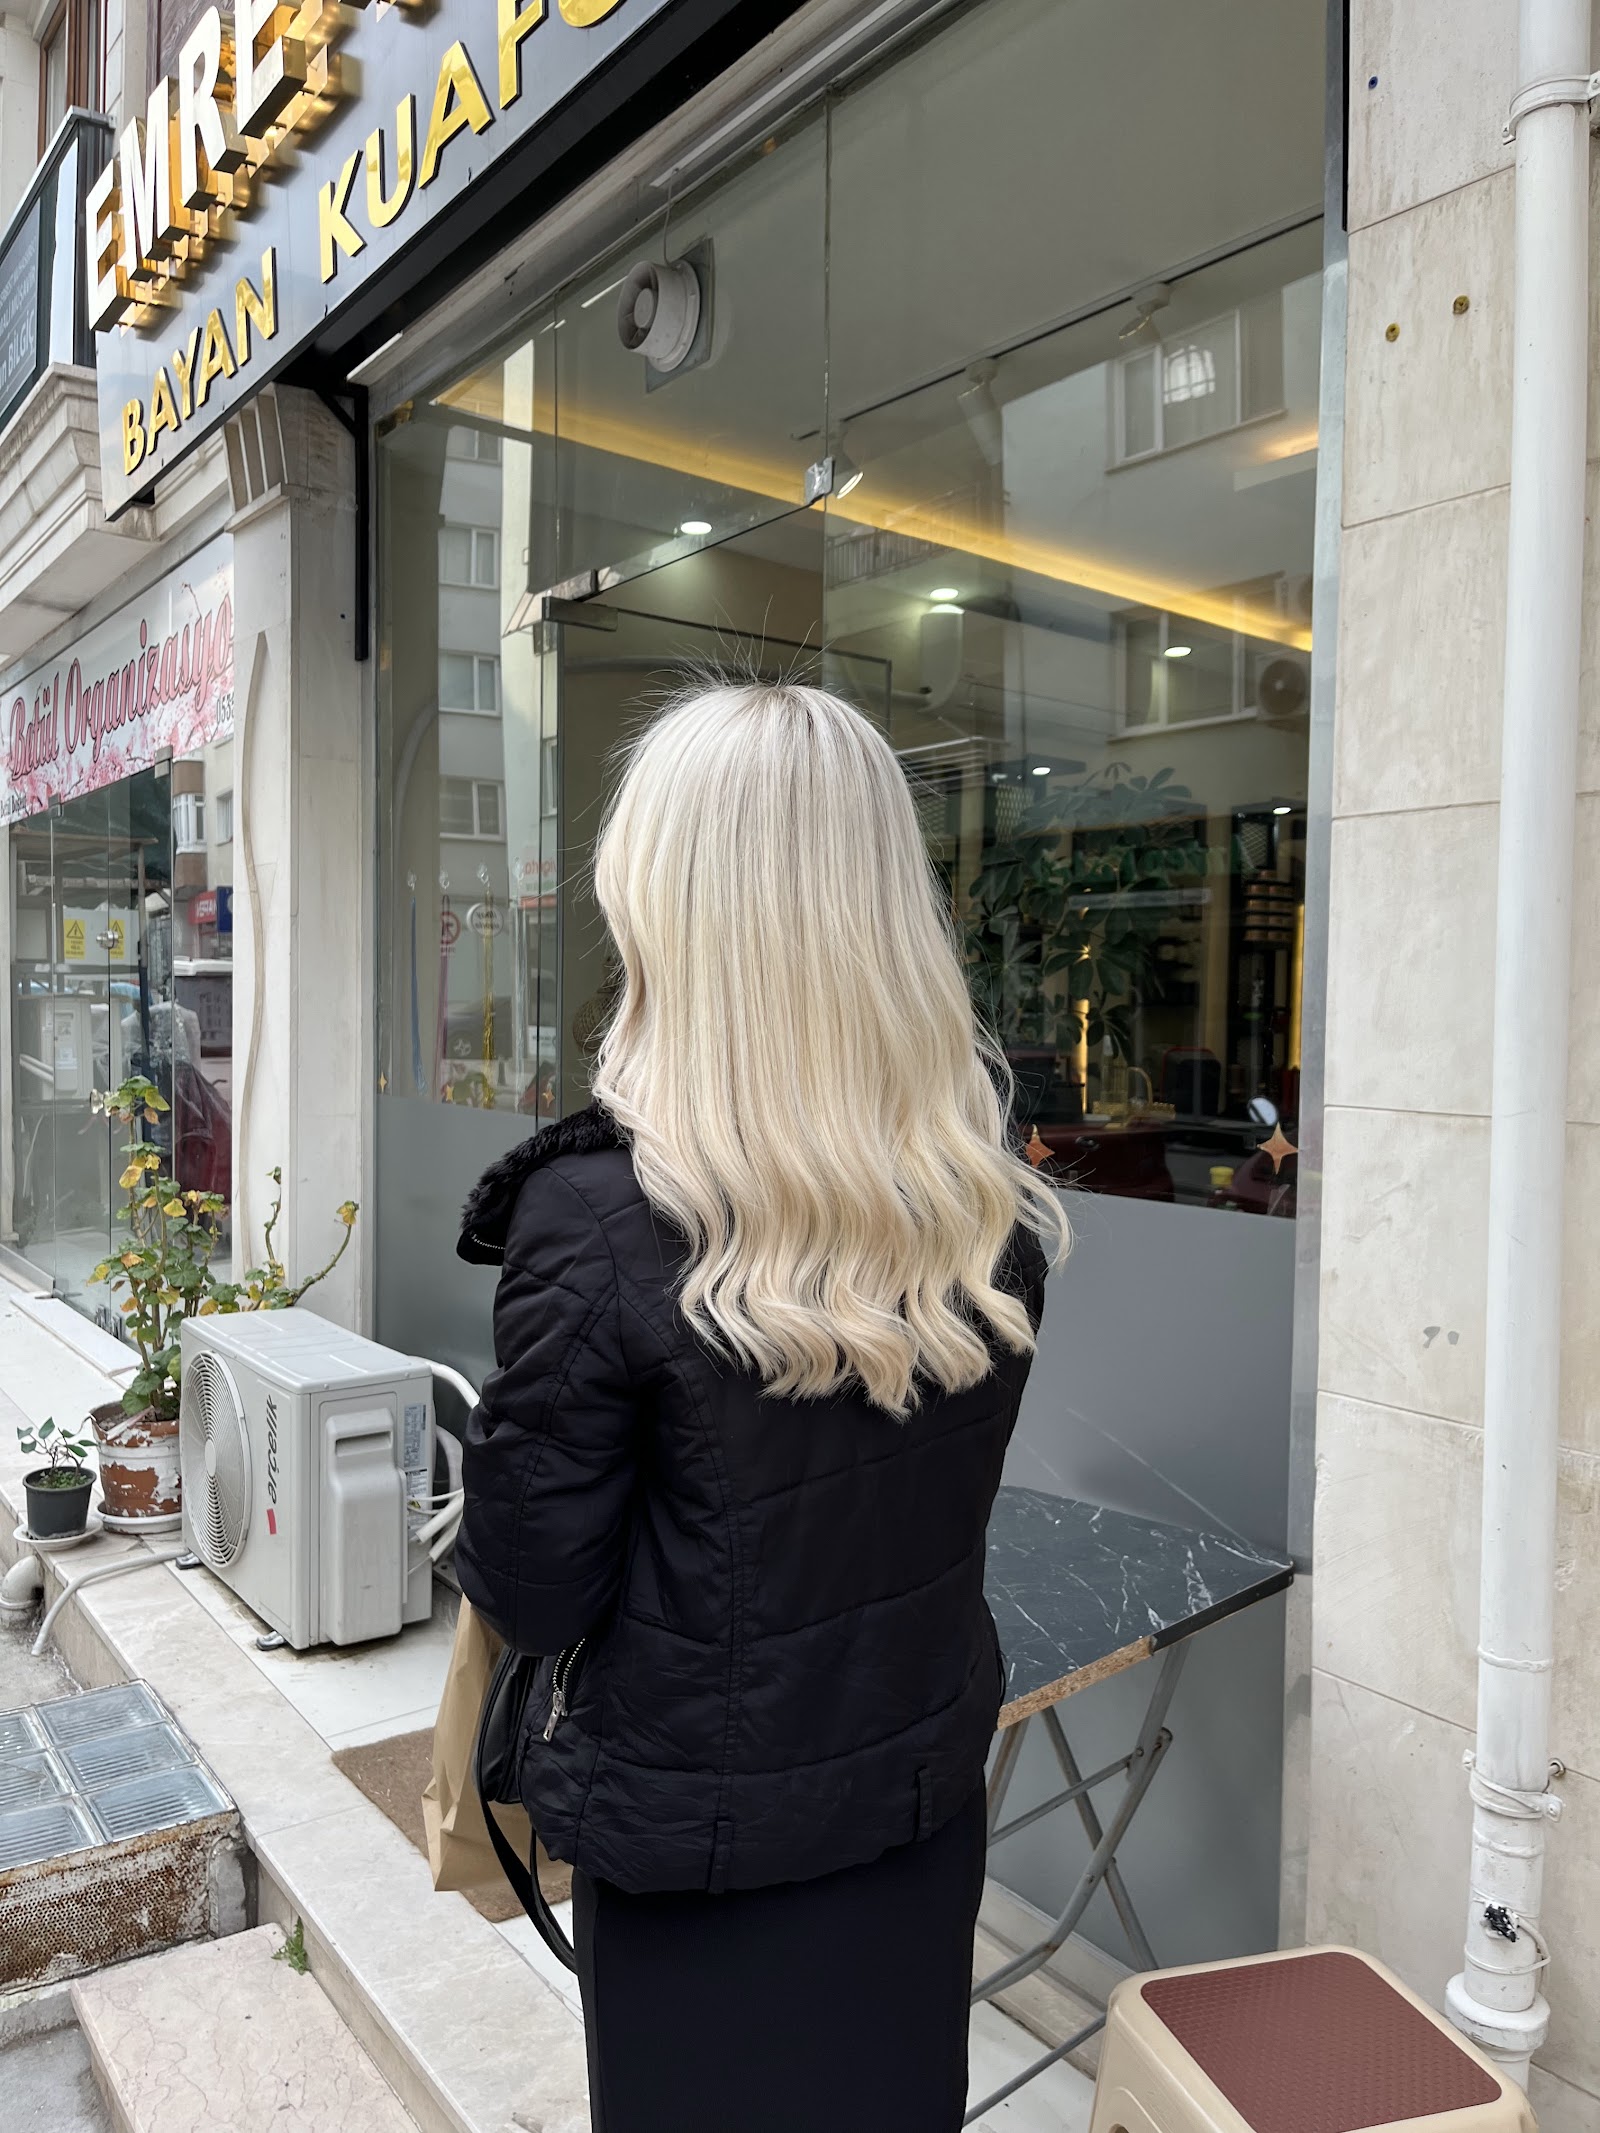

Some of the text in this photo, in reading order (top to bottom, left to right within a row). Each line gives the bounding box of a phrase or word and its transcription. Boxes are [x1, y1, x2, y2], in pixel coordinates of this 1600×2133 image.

[86, 0, 308, 331] EMRE
[123, 0, 628, 476] BAYAN KUAF
[9, 592, 235, 782] Betül Organizasyo
[266, 1394, 280, 1505] arçelik
